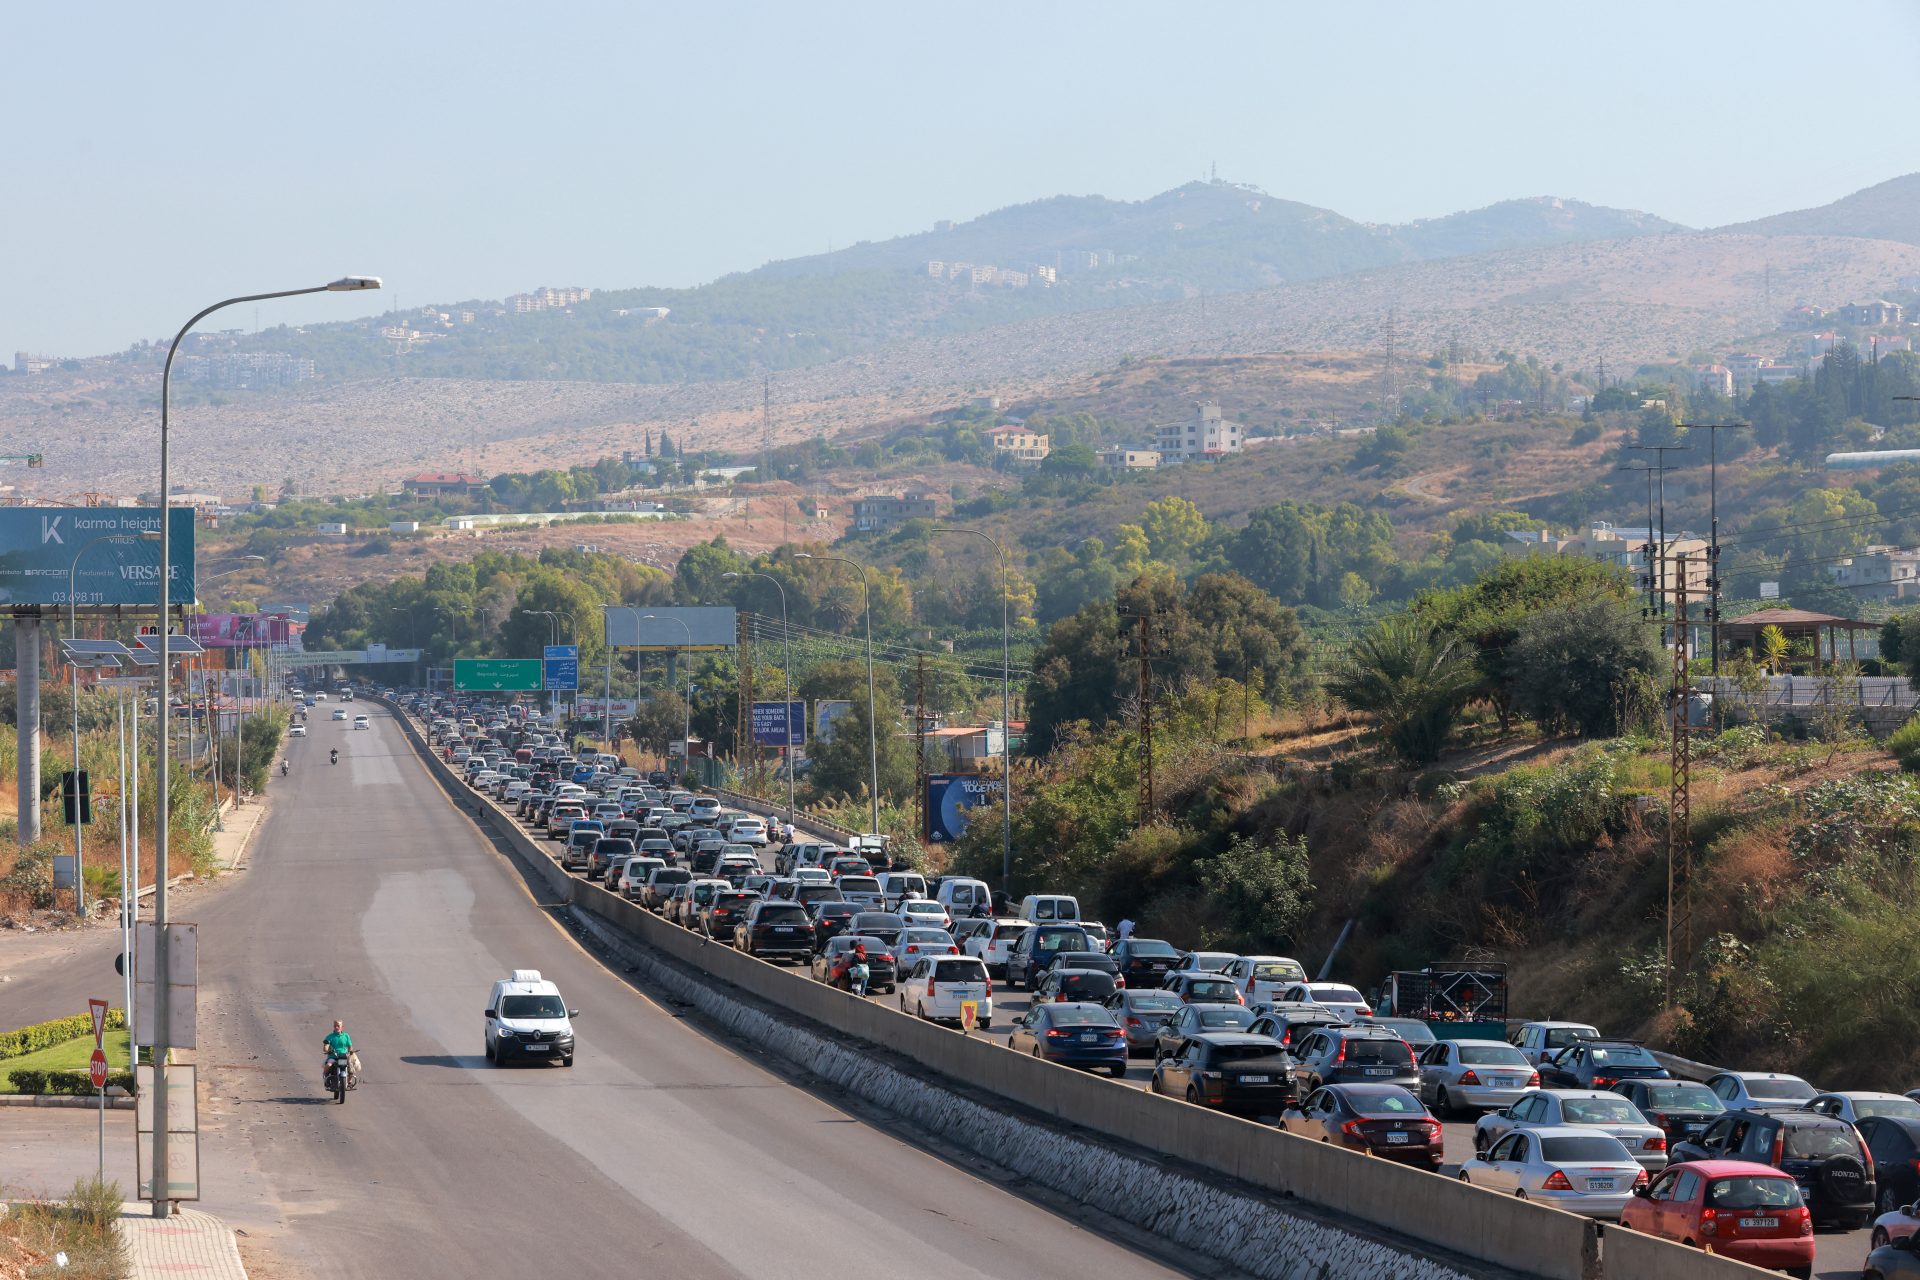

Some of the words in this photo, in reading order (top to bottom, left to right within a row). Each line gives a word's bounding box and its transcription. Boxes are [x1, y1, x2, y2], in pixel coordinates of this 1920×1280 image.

[75, 517, 116, 529] karma
[52, 592, 66, 602] 03
[90, 592, 103, 602] 111
[91, 1061, 106, 1075] STOP
[1832, 1170, 1860, 1179] HONDA
